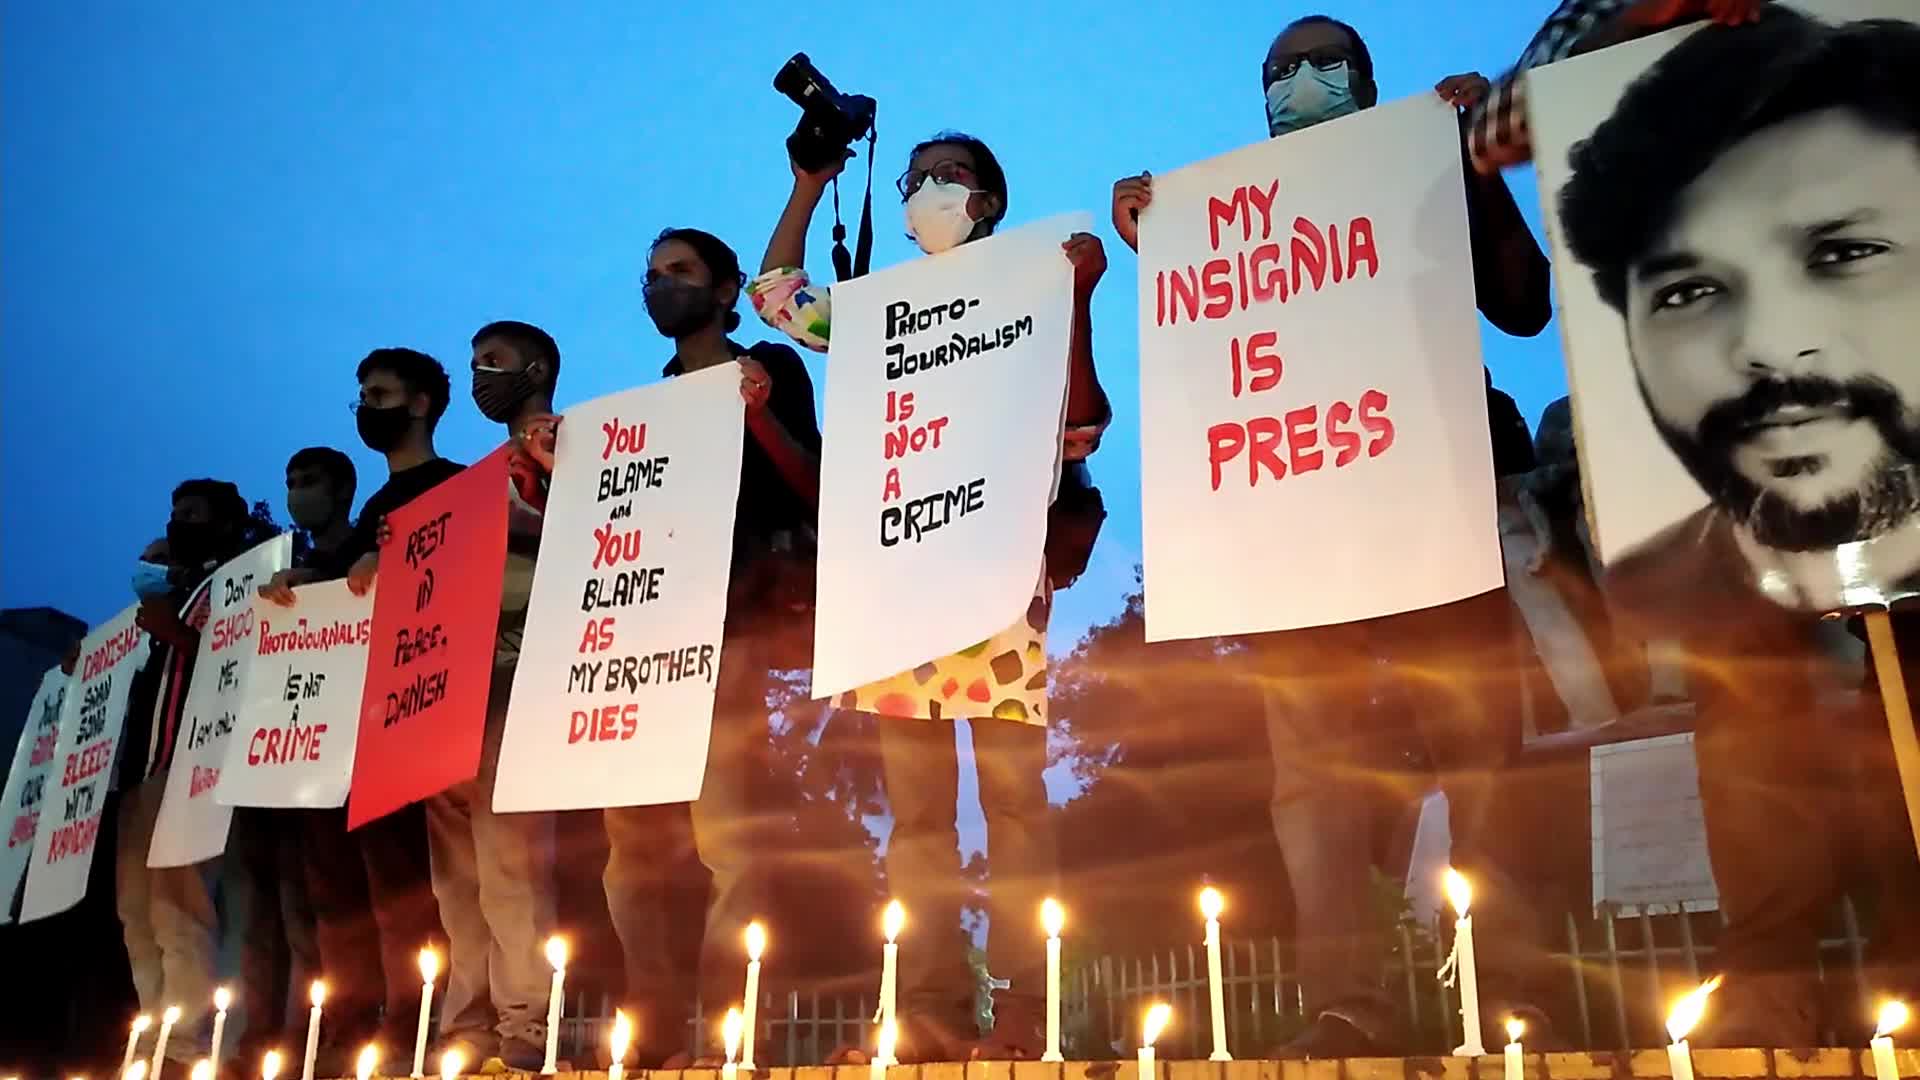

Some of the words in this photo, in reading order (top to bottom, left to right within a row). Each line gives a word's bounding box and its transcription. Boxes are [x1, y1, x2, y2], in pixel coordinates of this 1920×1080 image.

[1208, 179, 1279, 250] MY
[1157, 216, 1378, 327] INSIGNIA
[885, 298, 980, 340] PHOTO-
[886, 315, 1032, 380] JOURNALISM
[1231, 332, 1283, 398] IS
[885, 391, 914, 423] IS
[602, 418, 647, 461] YOU
[884, 417, 949, 460] NOT
[1208, 390, 1394, 491] PRESS
[597, 456, 669, 503] BLAME
[882, 468, 901, 503] A
[609, 500, 632, 521] and
[880, 478, 985, 547] CRIME
[405, 512, 452, 571] REST
[592, 523, 642, 570] YOU
[415, 567, 434, 613] IN
[581, 567, 665, 612] BLAME
[211, 607, 255, 652] SHOO
[257, 618, 370, 655] PHOTOJOURNALIS
[393, 624, 447, 668] PEACE.
[579, 617, 616, 653] AS
[283, 664, 303, 702] IS
[303, 671, 326, 700] NOT
[567, 660, 603, 694] MY
[604, 643, 715, 695] BROTHER
[289, 702, 300, 729] A
[384, 669, 448, 729] DANISH
[188, 715, 197, 751] I
[214, 711, 236, 738] ONL
[247, 723, 328, 766] CRIME
[567, 703, 639, 744] DIES
